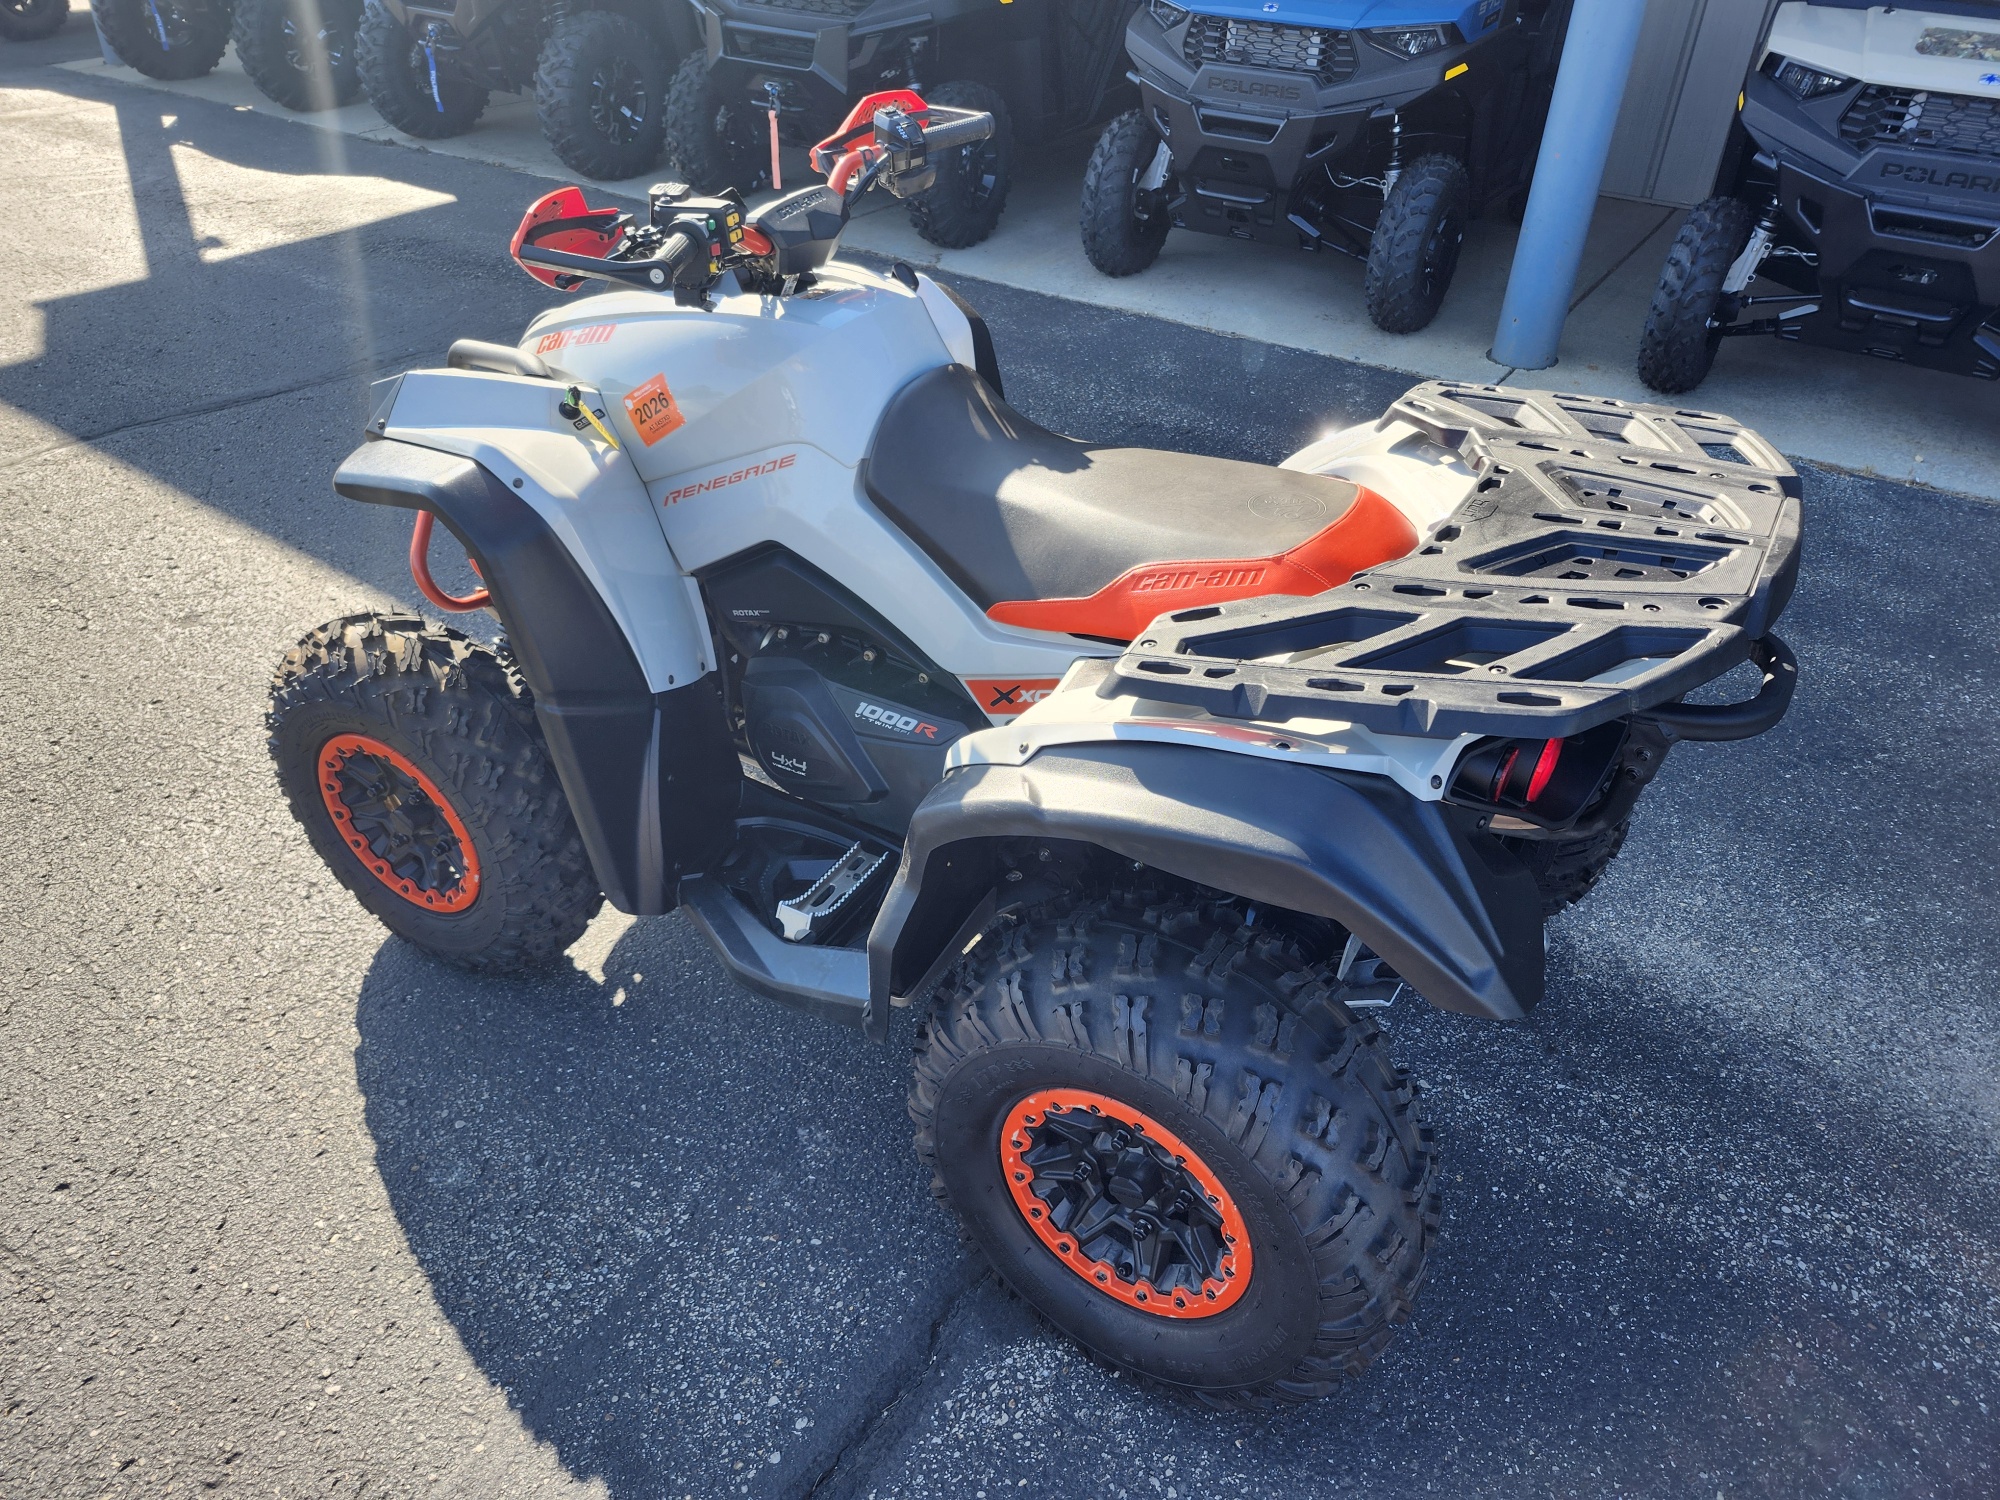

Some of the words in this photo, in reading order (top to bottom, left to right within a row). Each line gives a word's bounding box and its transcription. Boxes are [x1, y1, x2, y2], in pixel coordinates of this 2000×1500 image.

[1207, 76, 1300, 100] POLARIS
[634, 391, 670, 426] 2026
[663, 453, 797, 507] RENEGADE
[732, 609, 760, 617] ROTAX
[771, 751, 807, 771] 4x4
